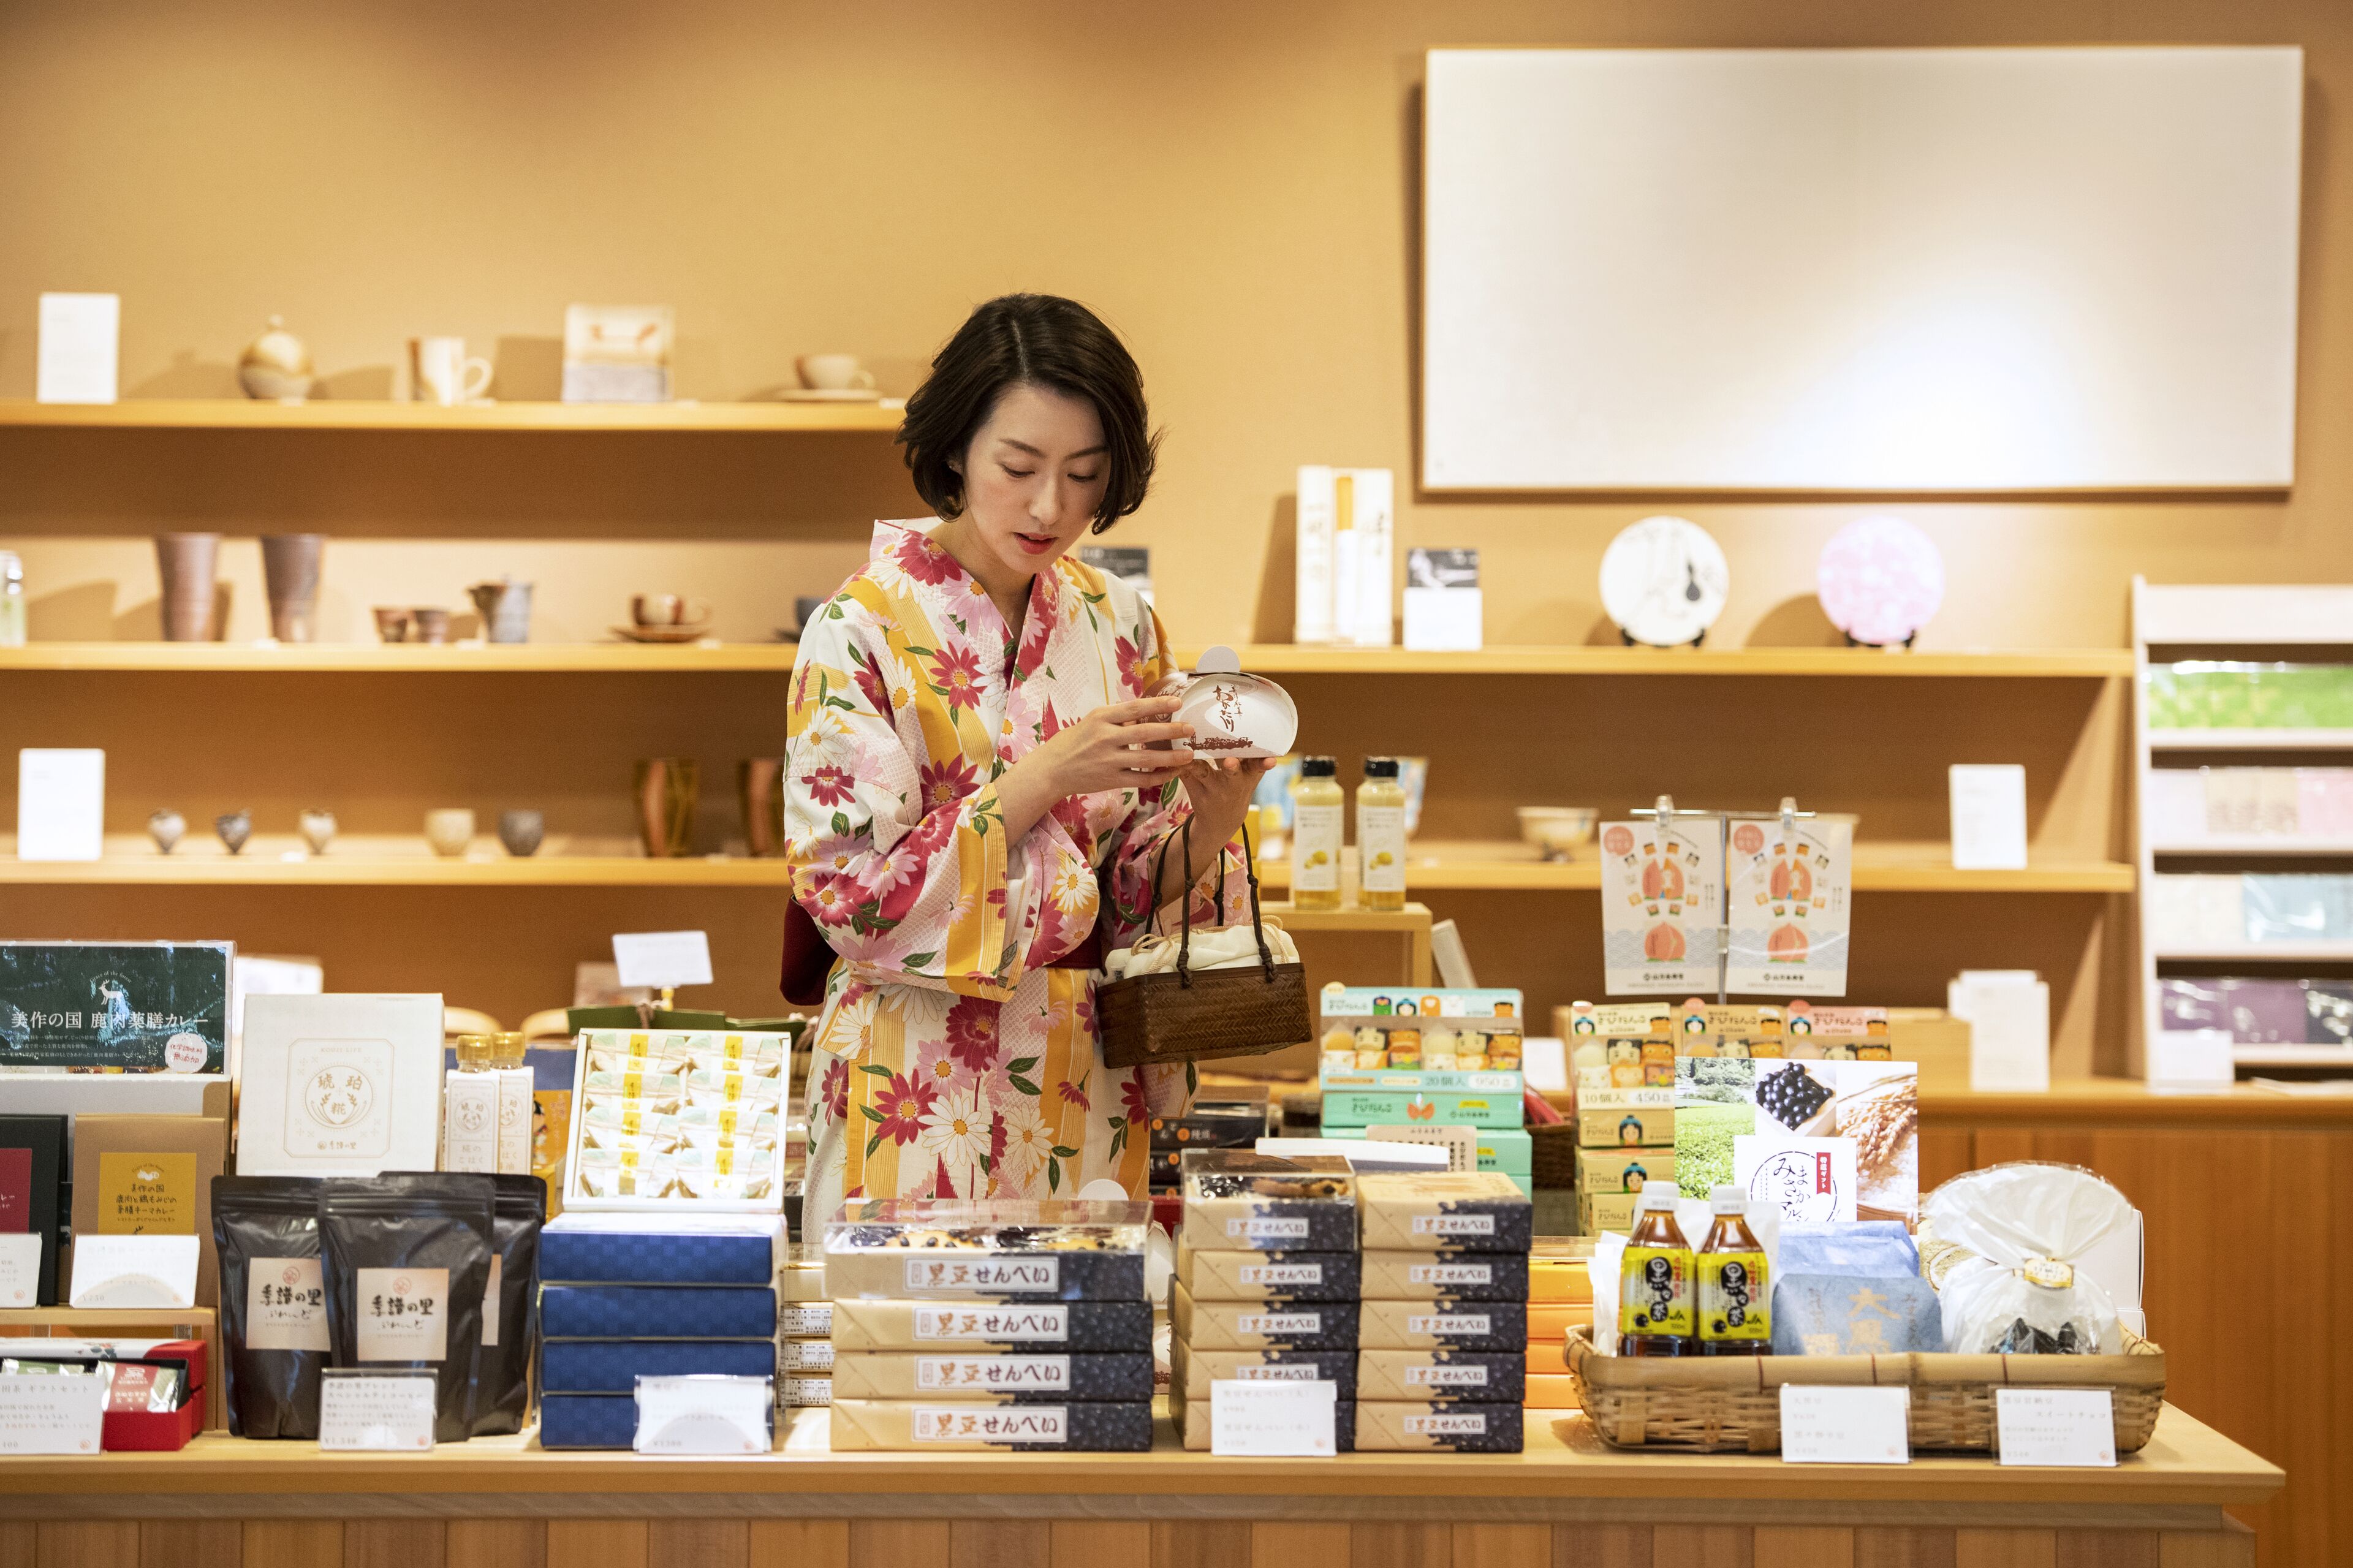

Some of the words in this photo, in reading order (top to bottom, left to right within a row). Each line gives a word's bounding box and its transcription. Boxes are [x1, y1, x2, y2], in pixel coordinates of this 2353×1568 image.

[11, 1011, 81, 1029] 美作の国
[91, 1011, 208, 1029] 鹿肉薬膳カレー
[132, 1183, 165, 1193] 美作の国
[927, 1263, 1050, 1286] 黒豆せんべい
[260, 1284, 322, 1306] 季譜の里
[371, 1294, 434, 1317] 季譜の里
[936, 1312, 1059, 1336] 黒豆せんべい
[938, 1362, 1061, 1386] 黒豆せんべい
[936, 1413, 1059, 1437] 黒豆せんべい
